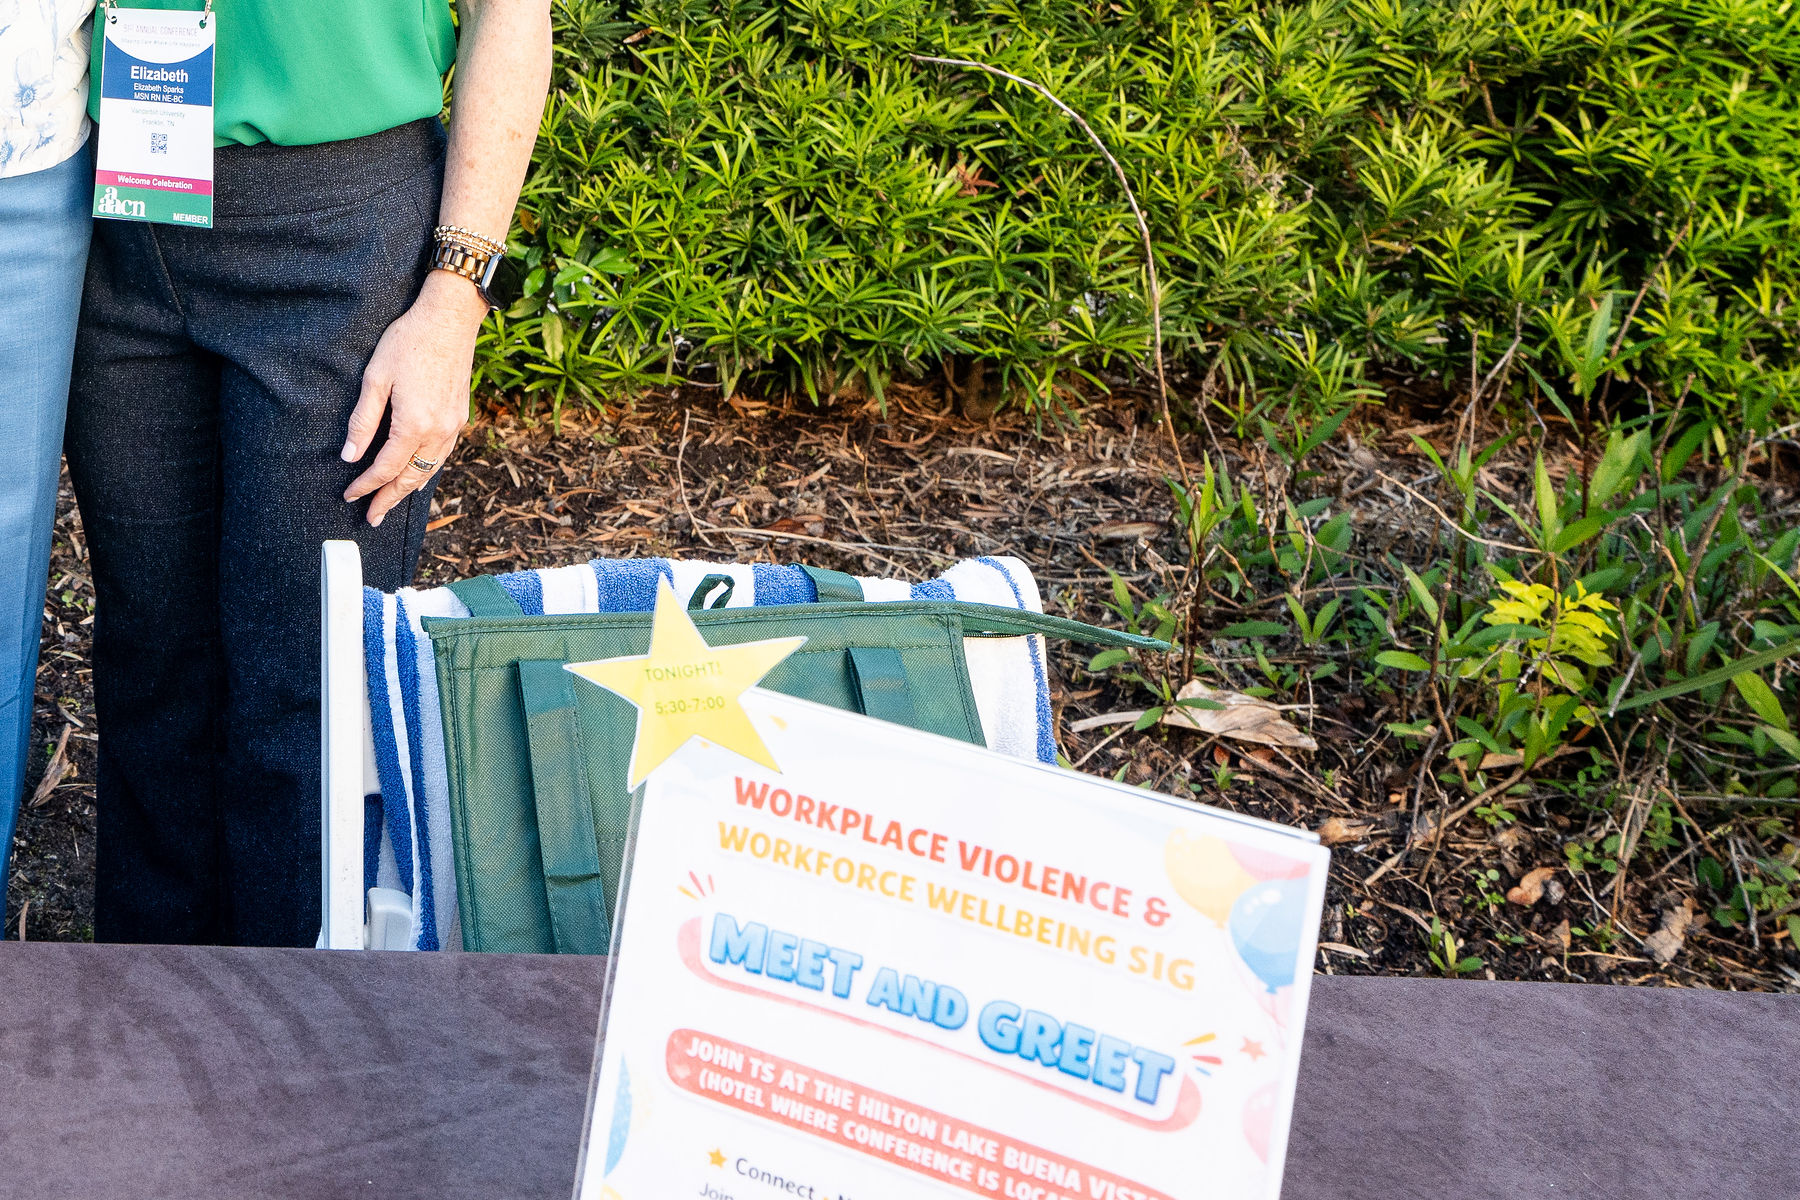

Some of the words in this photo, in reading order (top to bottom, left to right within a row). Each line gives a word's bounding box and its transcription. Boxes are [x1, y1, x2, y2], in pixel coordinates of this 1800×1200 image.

[130, 65, 189, 83] Elizabeth
[134, 82, 162, 92] Elizabeth
[163, 85, 184, 94] Sparks
[134, 92, 149, 100] MSN
[151, 92, 161, 101] RN
[162, 94, 184, 103] NE-BC
[117, 174, 151, 186] Welcome
[152, 178, 192, 190] Celebration
[173, 212, 208, 224] MEMBER
[645, 661, 722, 680] TONIGHT!
[654, 695, 725, 714] 5:30-7:00
[734, 776, 949, 864] WORKPLACE
[958, 840, 1132, 918] VIOLENCE
[1143, 896, 1171, 927] &
[718, 820, 917, 902] WORKFORCE
[926, 882, 1116, 965] WELLBEING
[1128, 945, 1195, 991] SIG
[708, 912, 863, 999] MEET
[866, 967, 969, 1030] AND
[977, 1000, 1176, 1105] GREET
[686, 1037, 745, 1073] JOHN
[779, 1069, 810, 1094] AT
[813, 1079, 854, 1112] THE
[858, 1095, 938, 1141] HILTON
[941, 1124, 999, 1163] LAKE
[1003, 1145, 1081, 1193] BUENA
[699, 1068, 765, 1108] (HOTEL
[770, 1093, 839, 1133] WHERE
[842, 1121, 972, 1182] CONFERENCE
[977, 1167, 1000, 1191] IS
[736, 1157, 815, 1200] Connect
